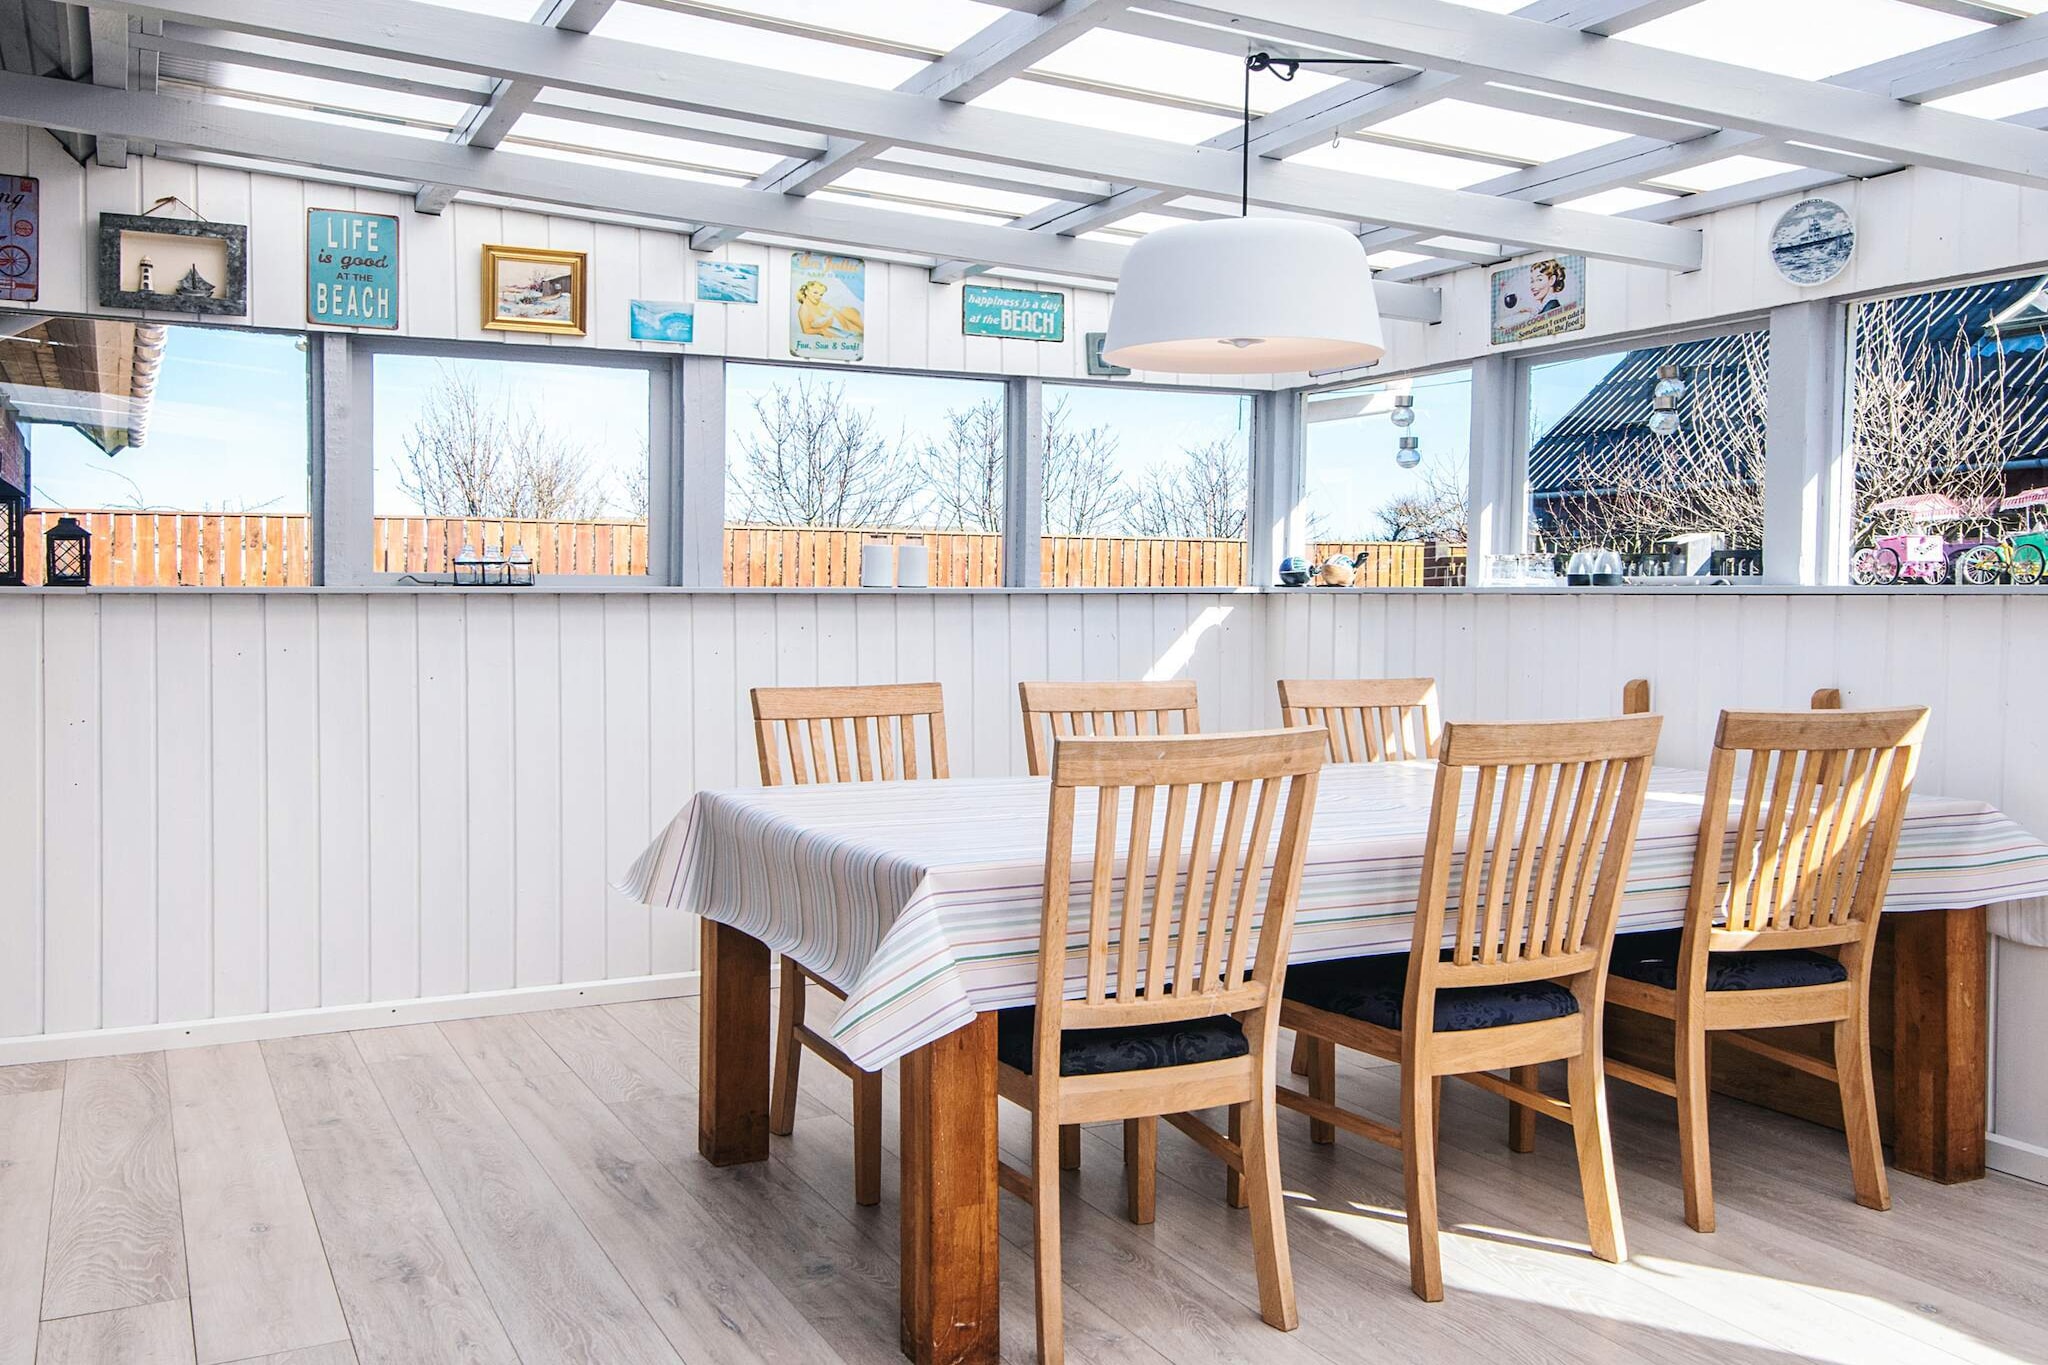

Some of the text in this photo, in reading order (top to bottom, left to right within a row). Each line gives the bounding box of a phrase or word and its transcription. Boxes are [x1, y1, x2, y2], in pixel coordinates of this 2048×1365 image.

[327, 216, 379, 252] LIFE
[318, 248, 389, 270] is good
[336, 272, 374, 283] AT THE
[317, 282, 389, 319] BEACH
[968, 294, 1060, 314] happiness is a day
[969, 308, 1055, 334] at the BEACH
[815, 341, 829, 350] Sun
[831, 342, 838, 350] &
